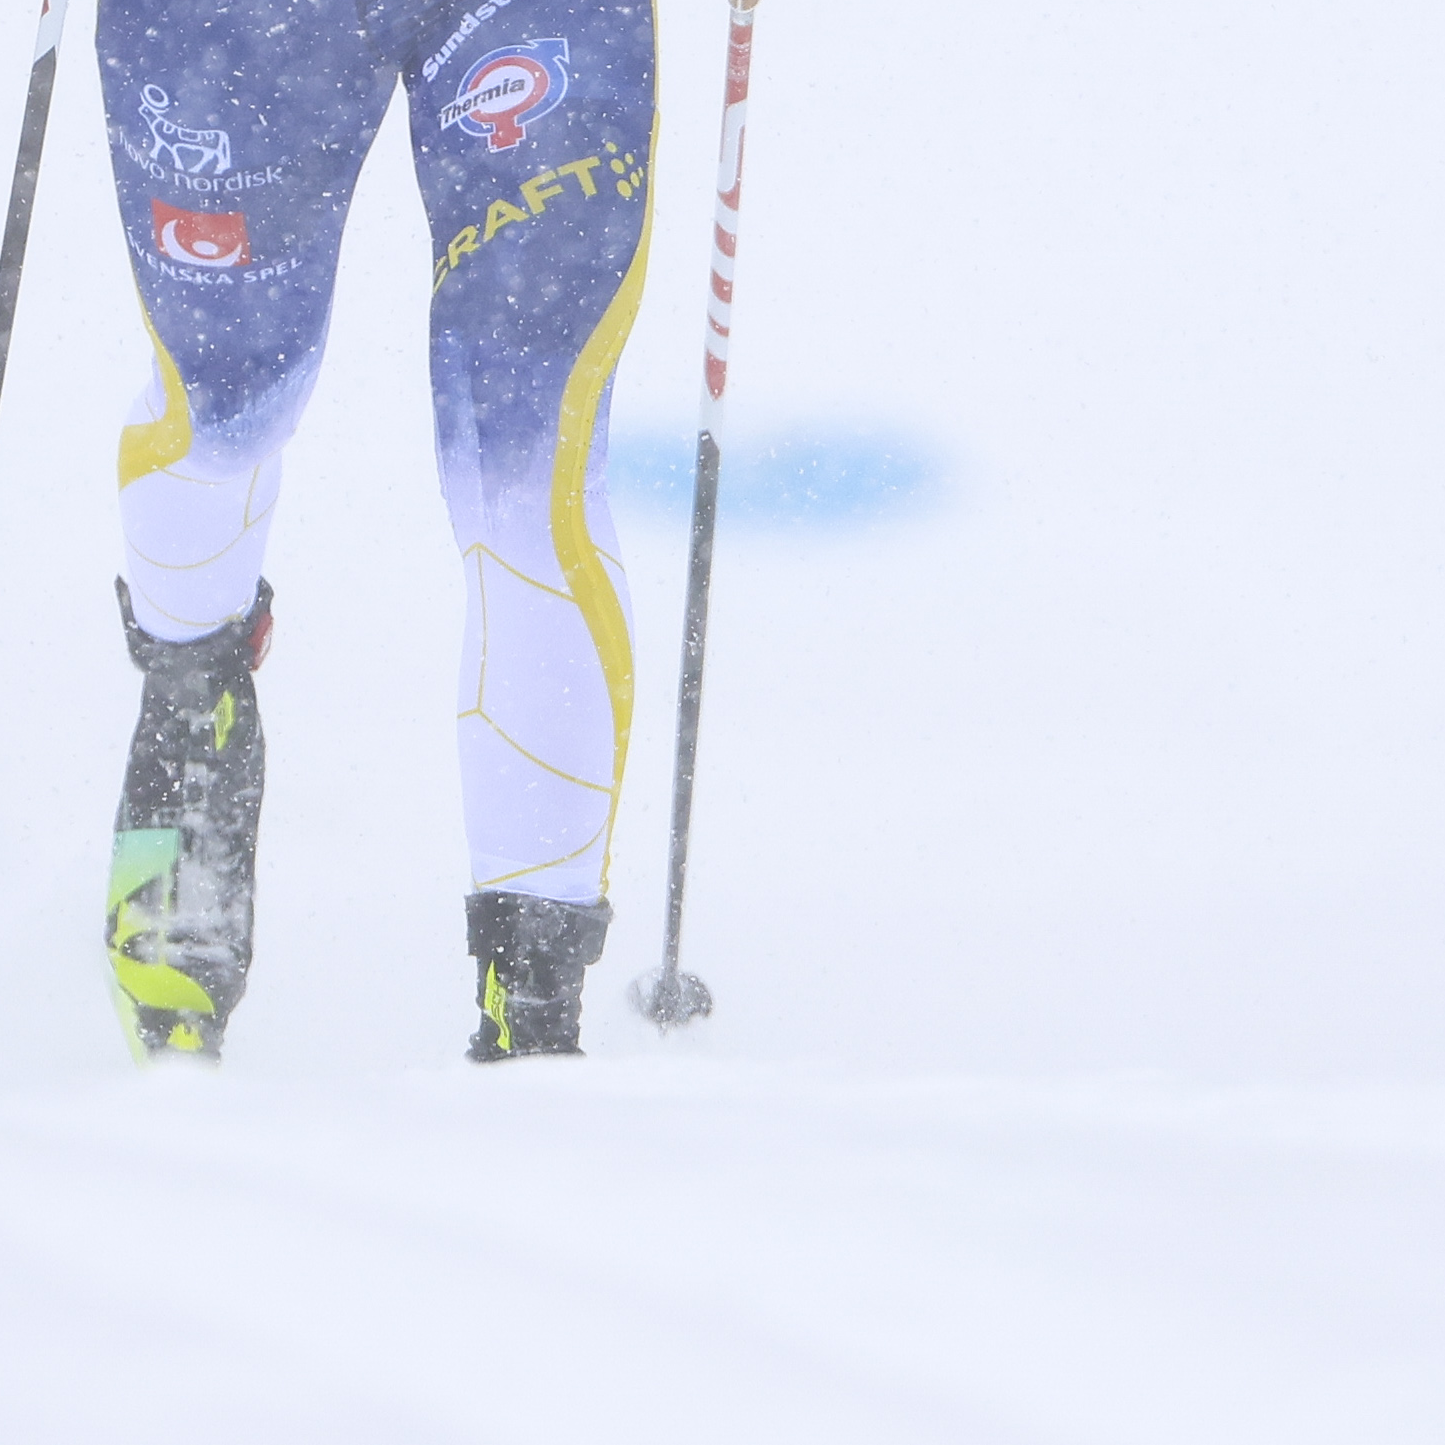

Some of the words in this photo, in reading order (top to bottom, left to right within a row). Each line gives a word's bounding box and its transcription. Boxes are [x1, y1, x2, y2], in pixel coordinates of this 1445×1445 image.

[442, 78, 526, 124] Thermia
[173, 165, 284, 192] nordisk
[243, 257, 303, 283] SPEL
